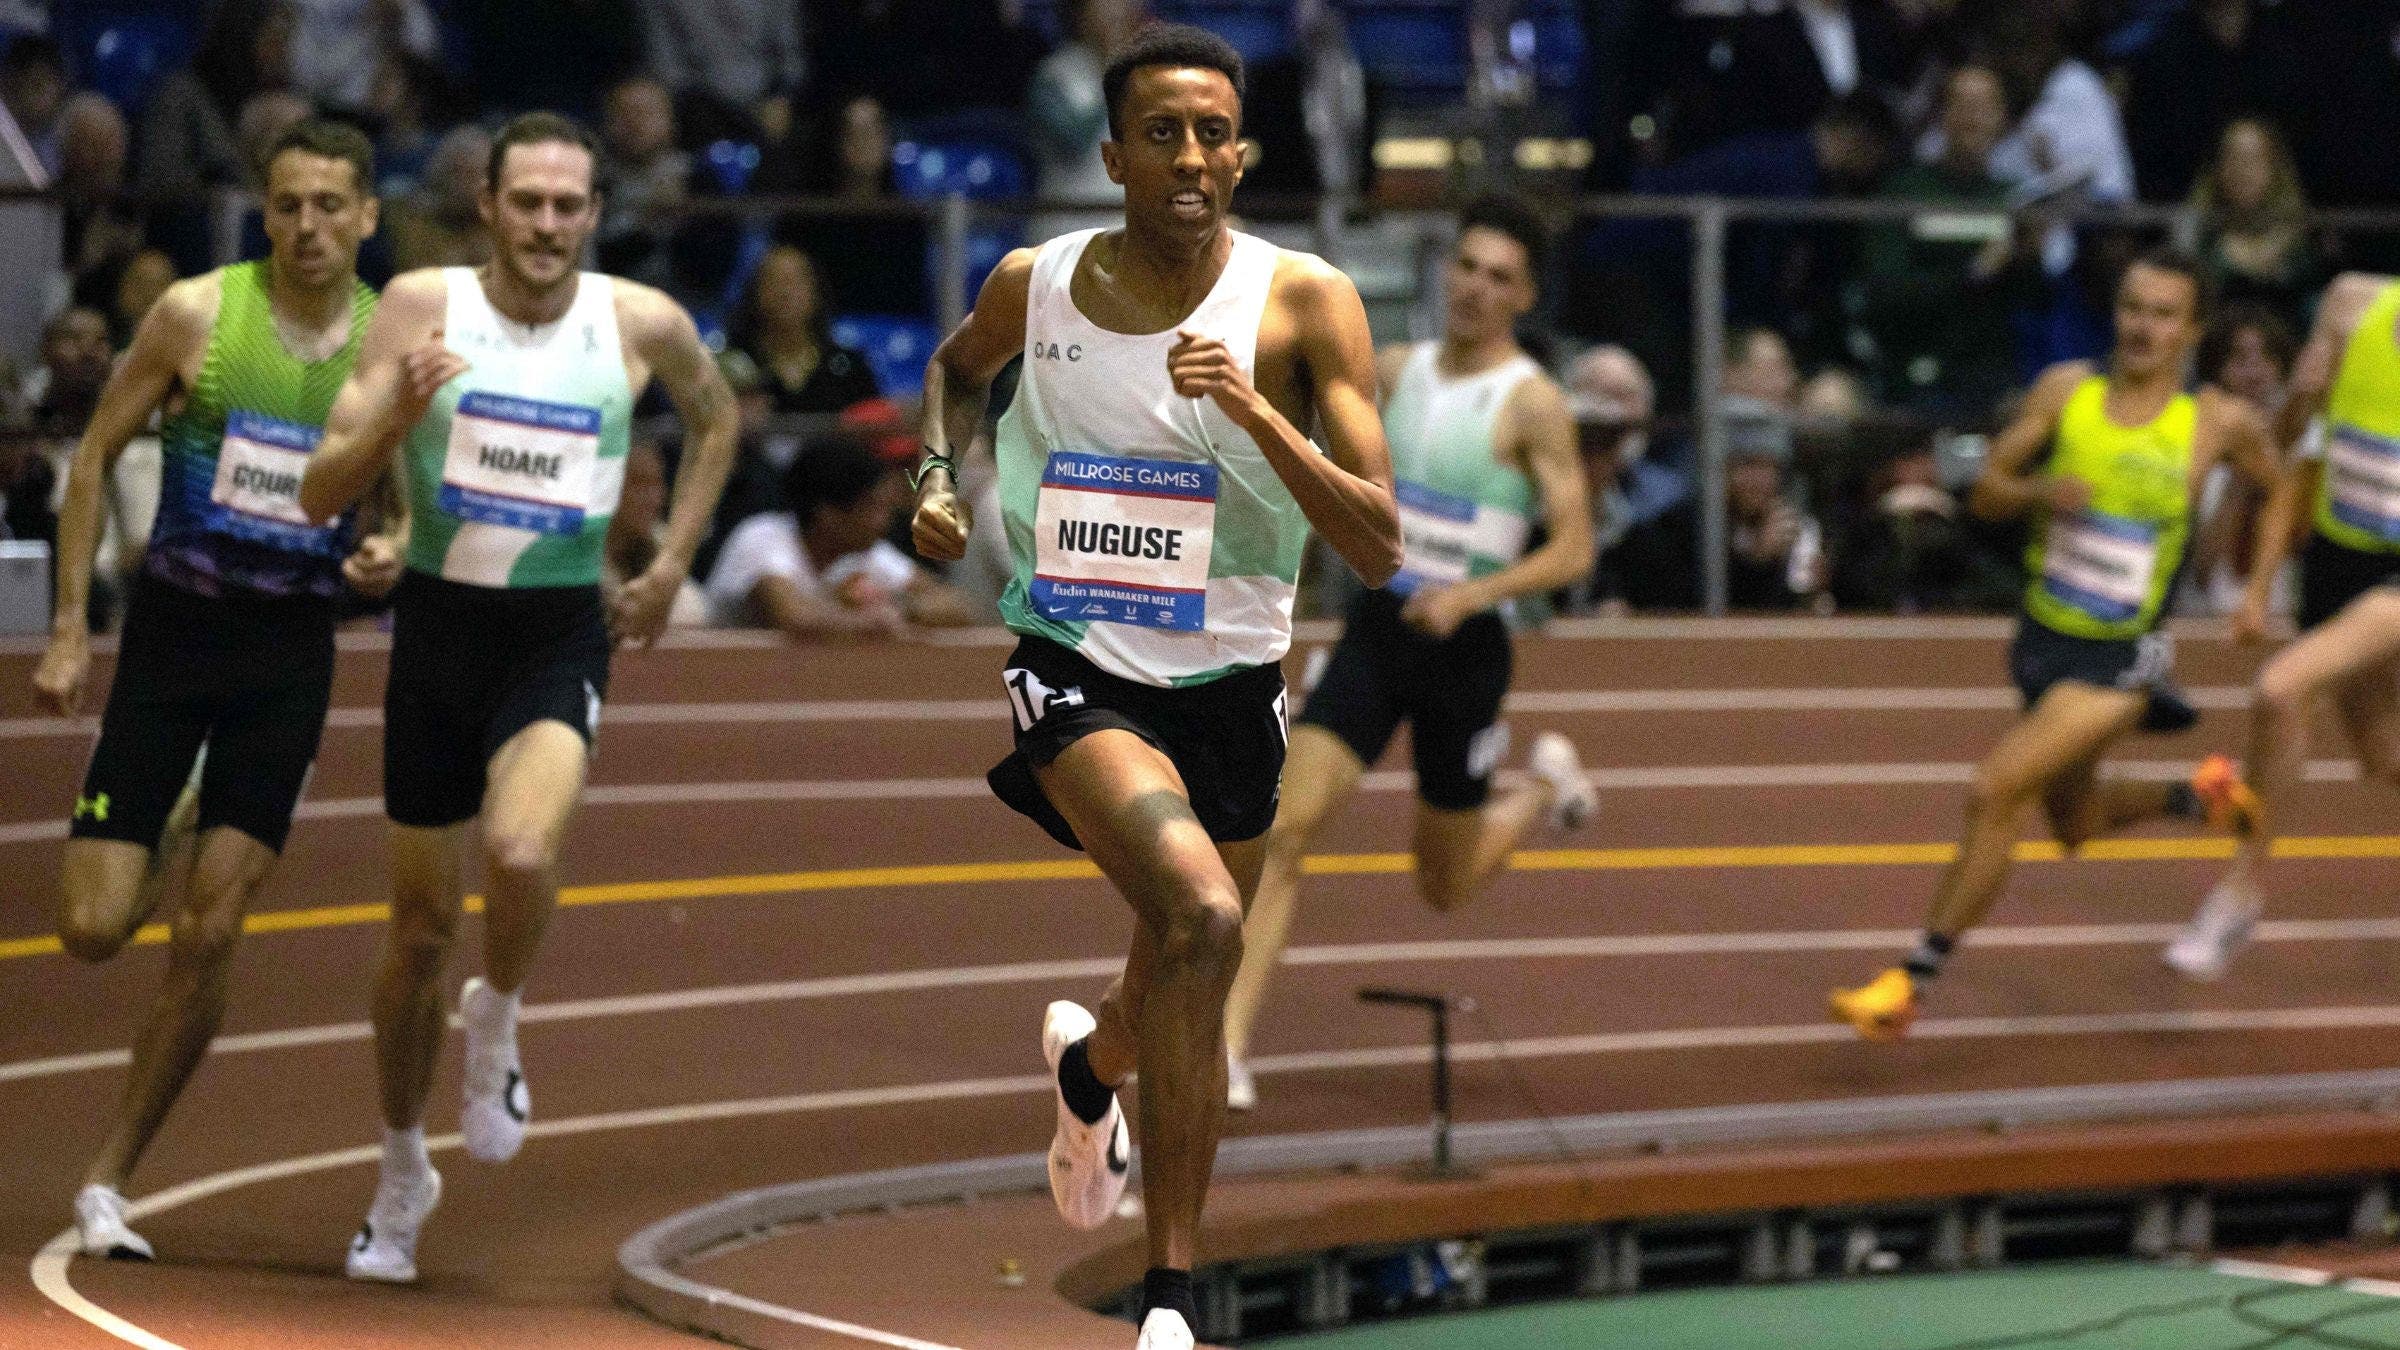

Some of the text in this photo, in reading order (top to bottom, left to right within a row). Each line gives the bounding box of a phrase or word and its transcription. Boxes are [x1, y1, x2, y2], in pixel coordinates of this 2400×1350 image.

[1035, 341, 1082, 362] OAC
[479, 444, 562, 481] HOARE
[1055, 462, 1201, 489] MILLROSE GAMES
[1058, 519, 1183, 561] NUGUSE
[1052, 583, 1176, 607] Rudin WANAMAKER MILE
